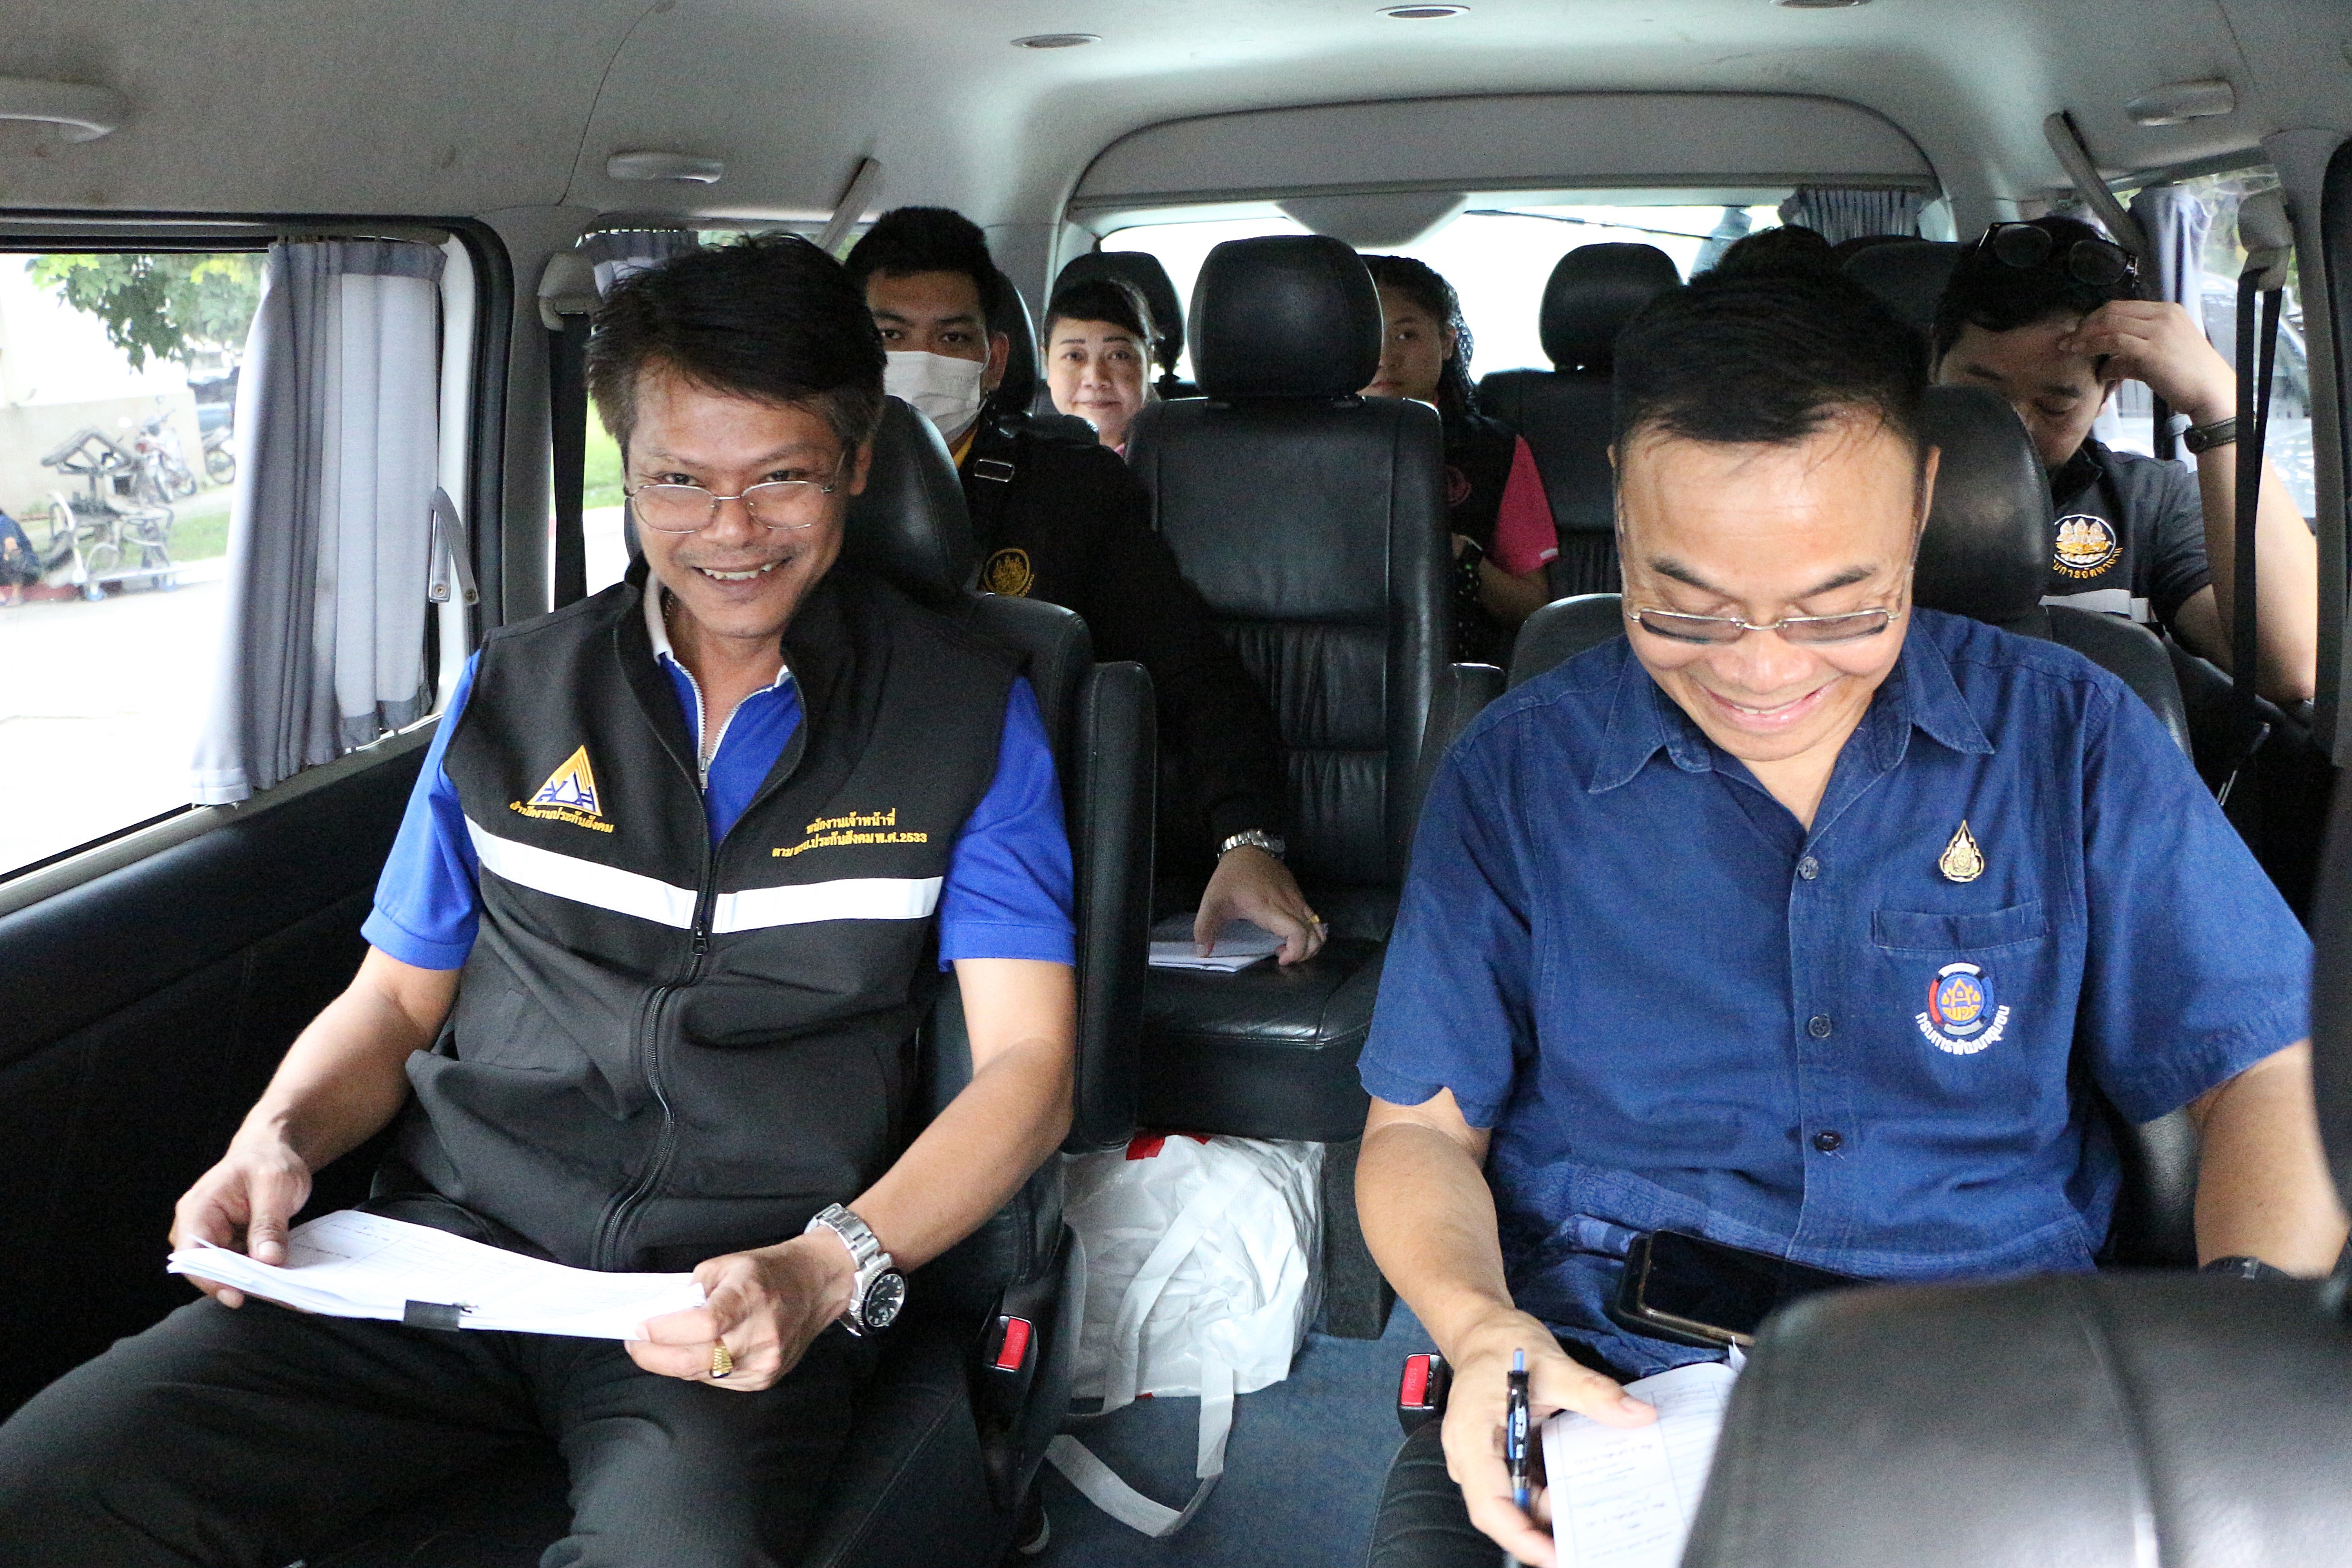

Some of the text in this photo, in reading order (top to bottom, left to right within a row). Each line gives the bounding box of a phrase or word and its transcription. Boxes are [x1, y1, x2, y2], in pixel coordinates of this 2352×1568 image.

[509, 800, 614, 833] สำนักงานประกันสังคม
[806, 807, 897, 834] พนักงานเจ้าหน้าที่
[1915, 1005, 2009, 1055] กรมการพัฒนาชุมชน
